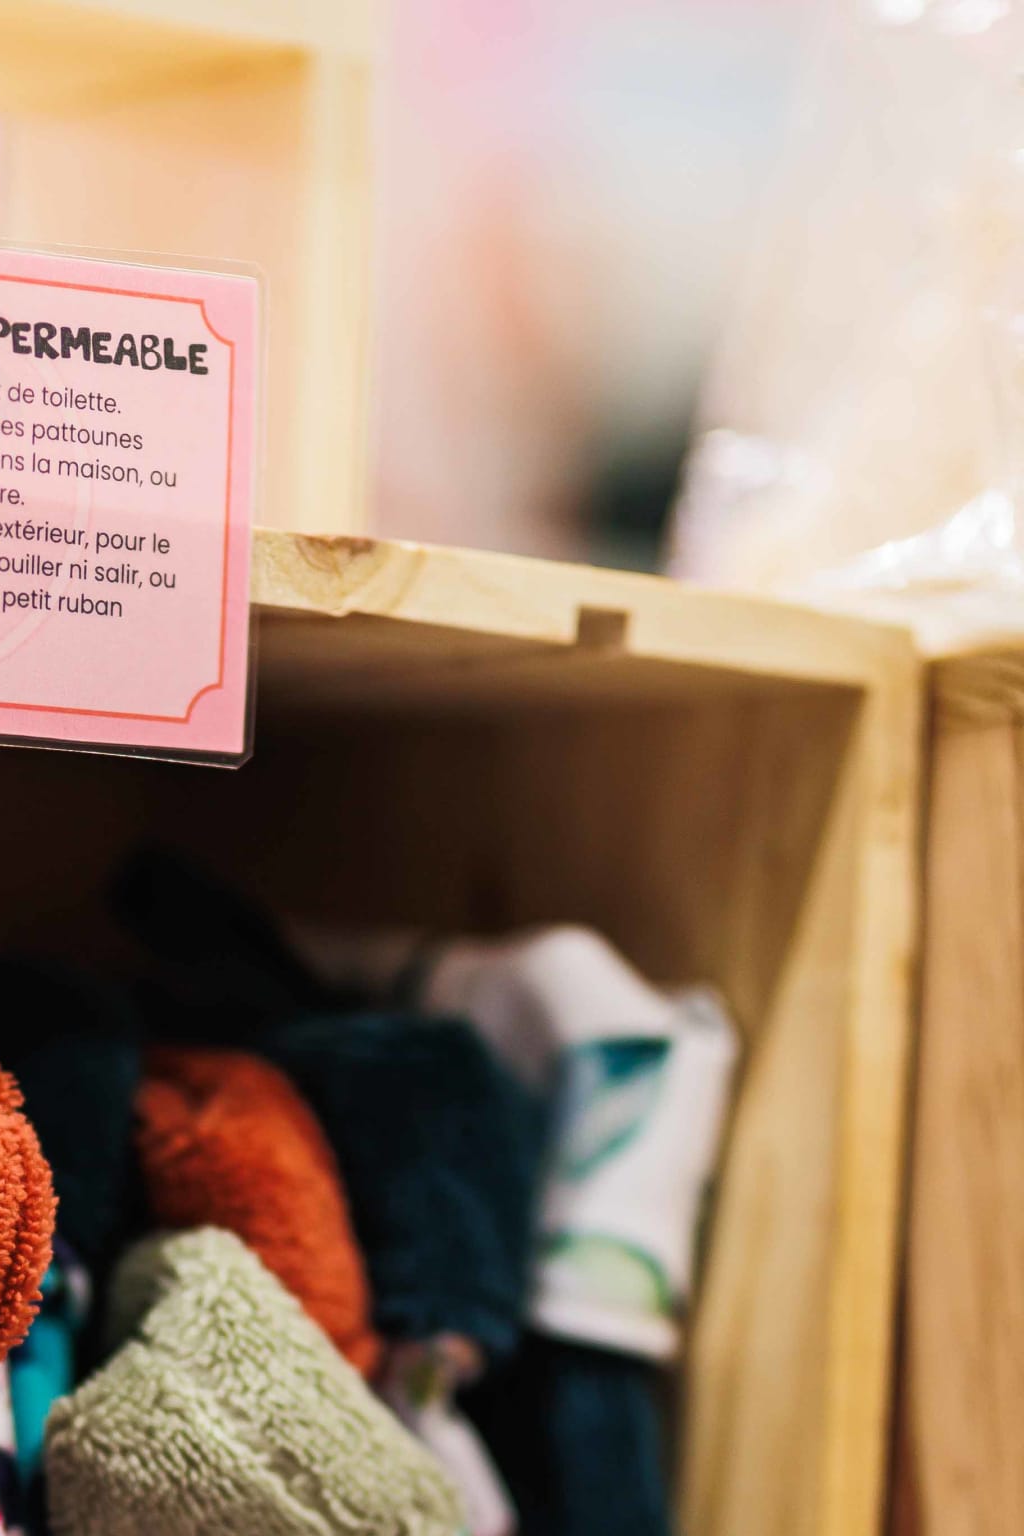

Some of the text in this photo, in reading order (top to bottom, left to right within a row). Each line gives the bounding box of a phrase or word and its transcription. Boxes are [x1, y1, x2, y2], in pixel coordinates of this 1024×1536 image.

[7, 382, 36, 405] de
[42, 387, 122, 415] toilette.
[31, 421, 144, 451] pattounes
[32, 454, 52, 475] la
[58, 459, 145, 488] maison,
[150, 470, 178, 488] ou
[96, 530, 148, 554] pour
[153, 533, 171, 555] le
[69, 560, 88, 580] ni
[94, 563, 144, 590] salir,
[149, 570, 177, 589] ou
[2, 588, 52, 613] petit
[58, 594, 124, 618] ruban
